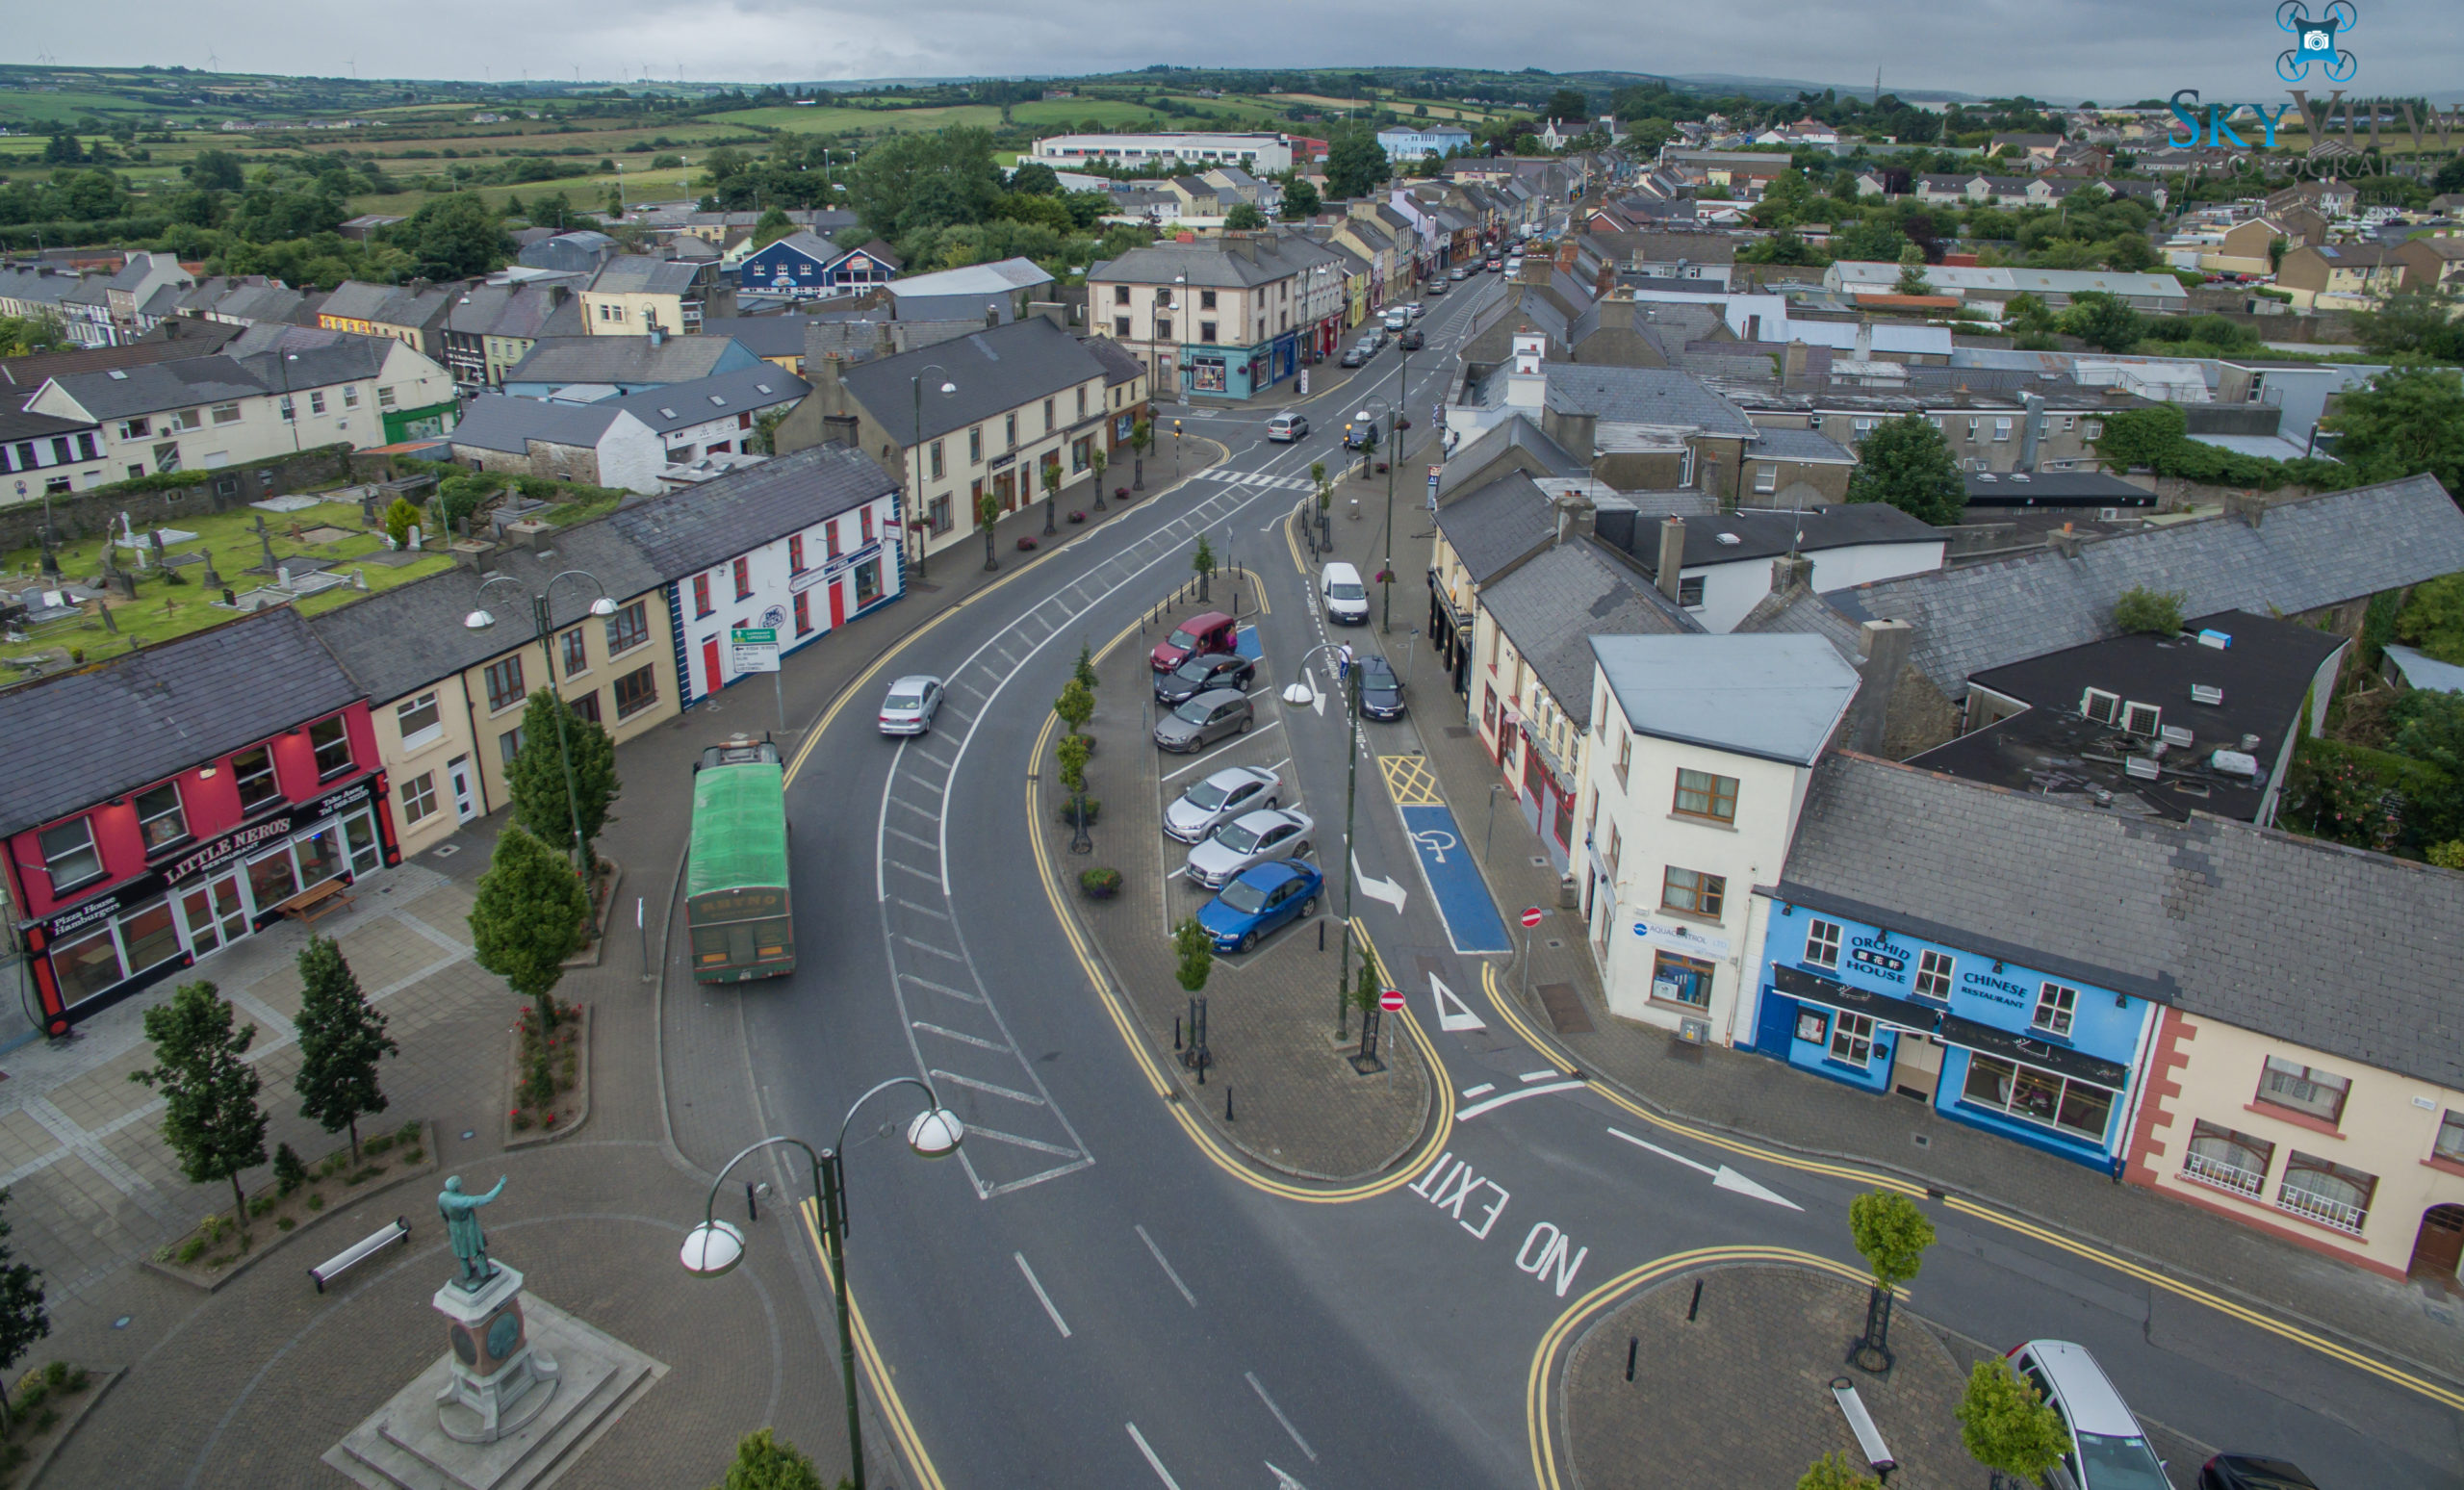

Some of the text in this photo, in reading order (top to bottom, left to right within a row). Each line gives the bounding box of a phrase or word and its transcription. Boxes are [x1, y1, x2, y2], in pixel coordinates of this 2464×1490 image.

[321, 785, 365, 807] Take Away
[163, 817, 291, 885] LITTLE NERO'S
[201, 841, 259, 871] RESTAURANT
[54, 896, 116, 928] Pizza House
[54, 902, 121, 937] Hamburgers
[1851, 937, 1911, 960] ORCHID
[1846, 960, 1906, 985] HOUSE
[1964, 972, 2028, 998] CHINESE
[1961, 987, 2025, 1009] RESTAURANT
[1407, 1151, 1588, 1297] NO EXIT
